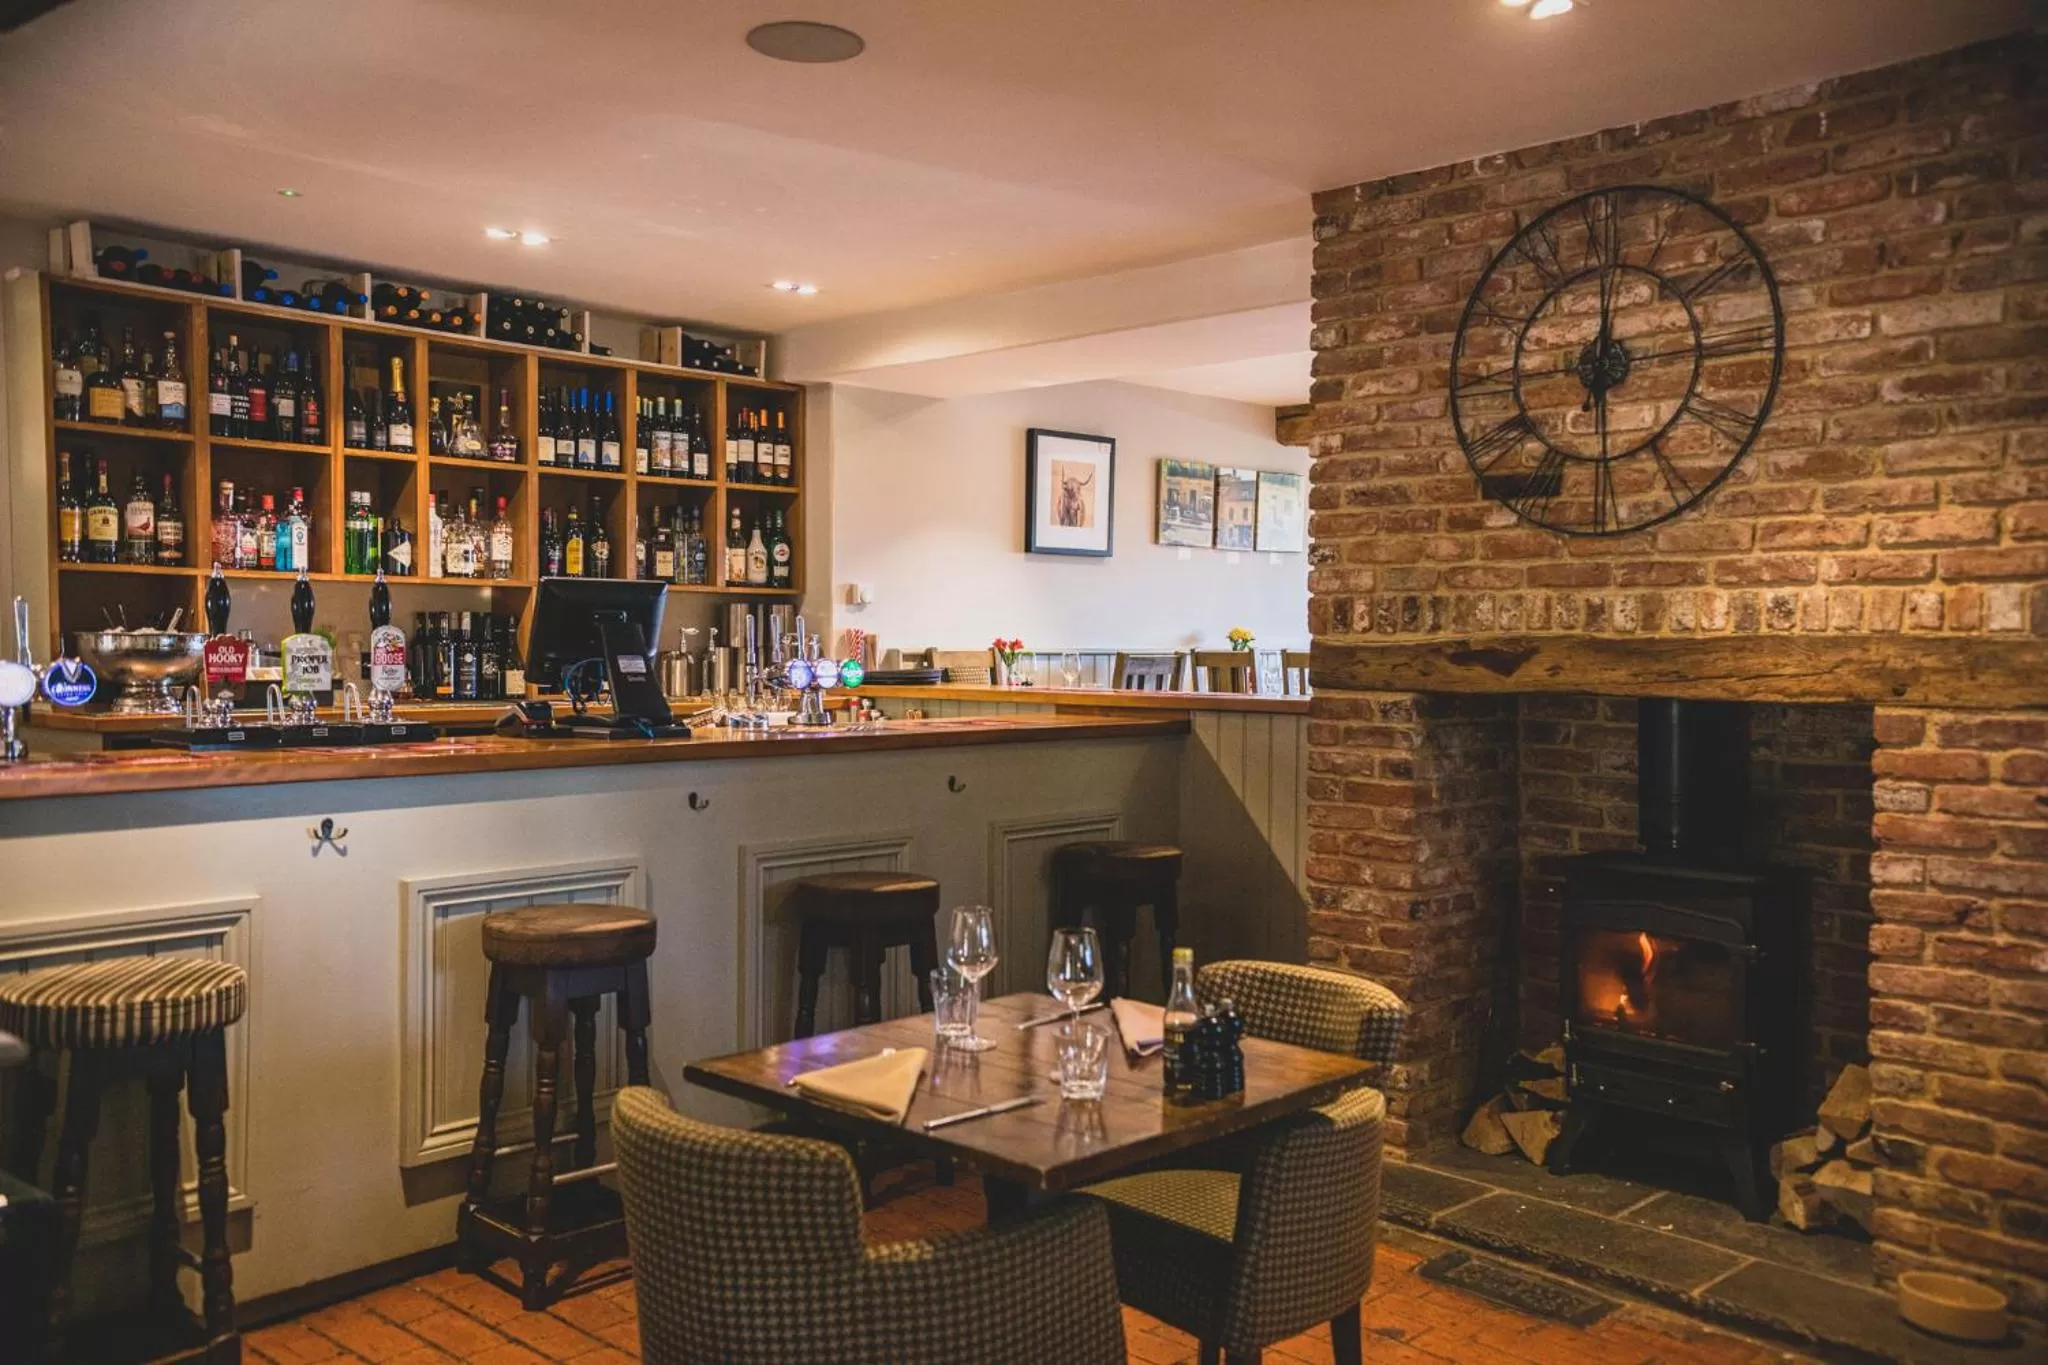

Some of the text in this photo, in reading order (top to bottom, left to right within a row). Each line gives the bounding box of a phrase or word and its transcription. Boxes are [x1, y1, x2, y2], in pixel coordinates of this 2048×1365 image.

[217, 645, 236, 654] OLD
[207, 653, 245, 664] HOOKY
[291, 654, 329, 665] PROPER
[374, 653, 404, 665] GOOSE
[302, 665, 320, 675] JOB
